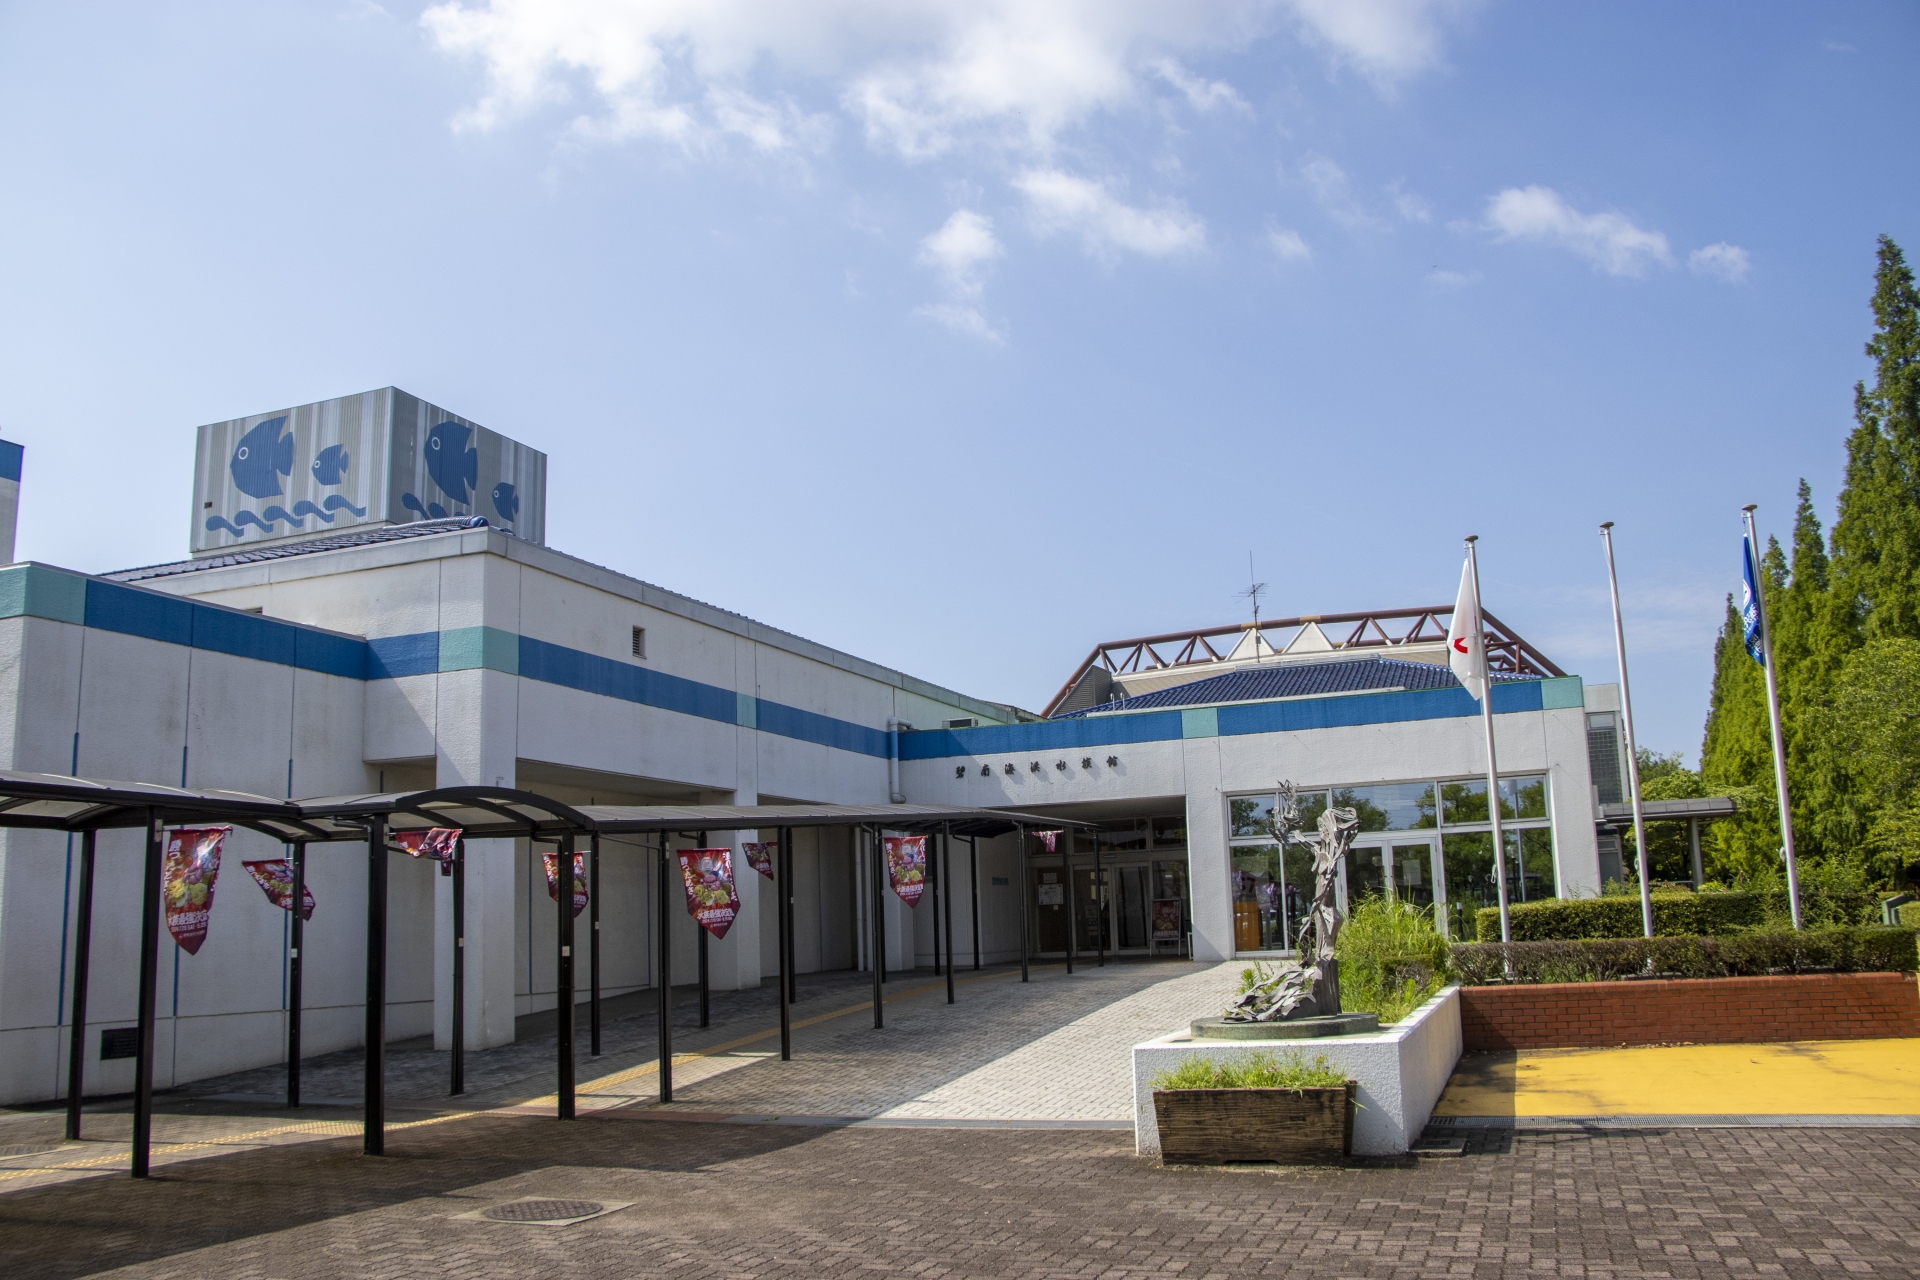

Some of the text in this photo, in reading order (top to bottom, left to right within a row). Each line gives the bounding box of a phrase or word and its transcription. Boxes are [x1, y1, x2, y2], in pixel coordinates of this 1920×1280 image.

[955, 755, 1118, 779] 碧南海浜水族館
